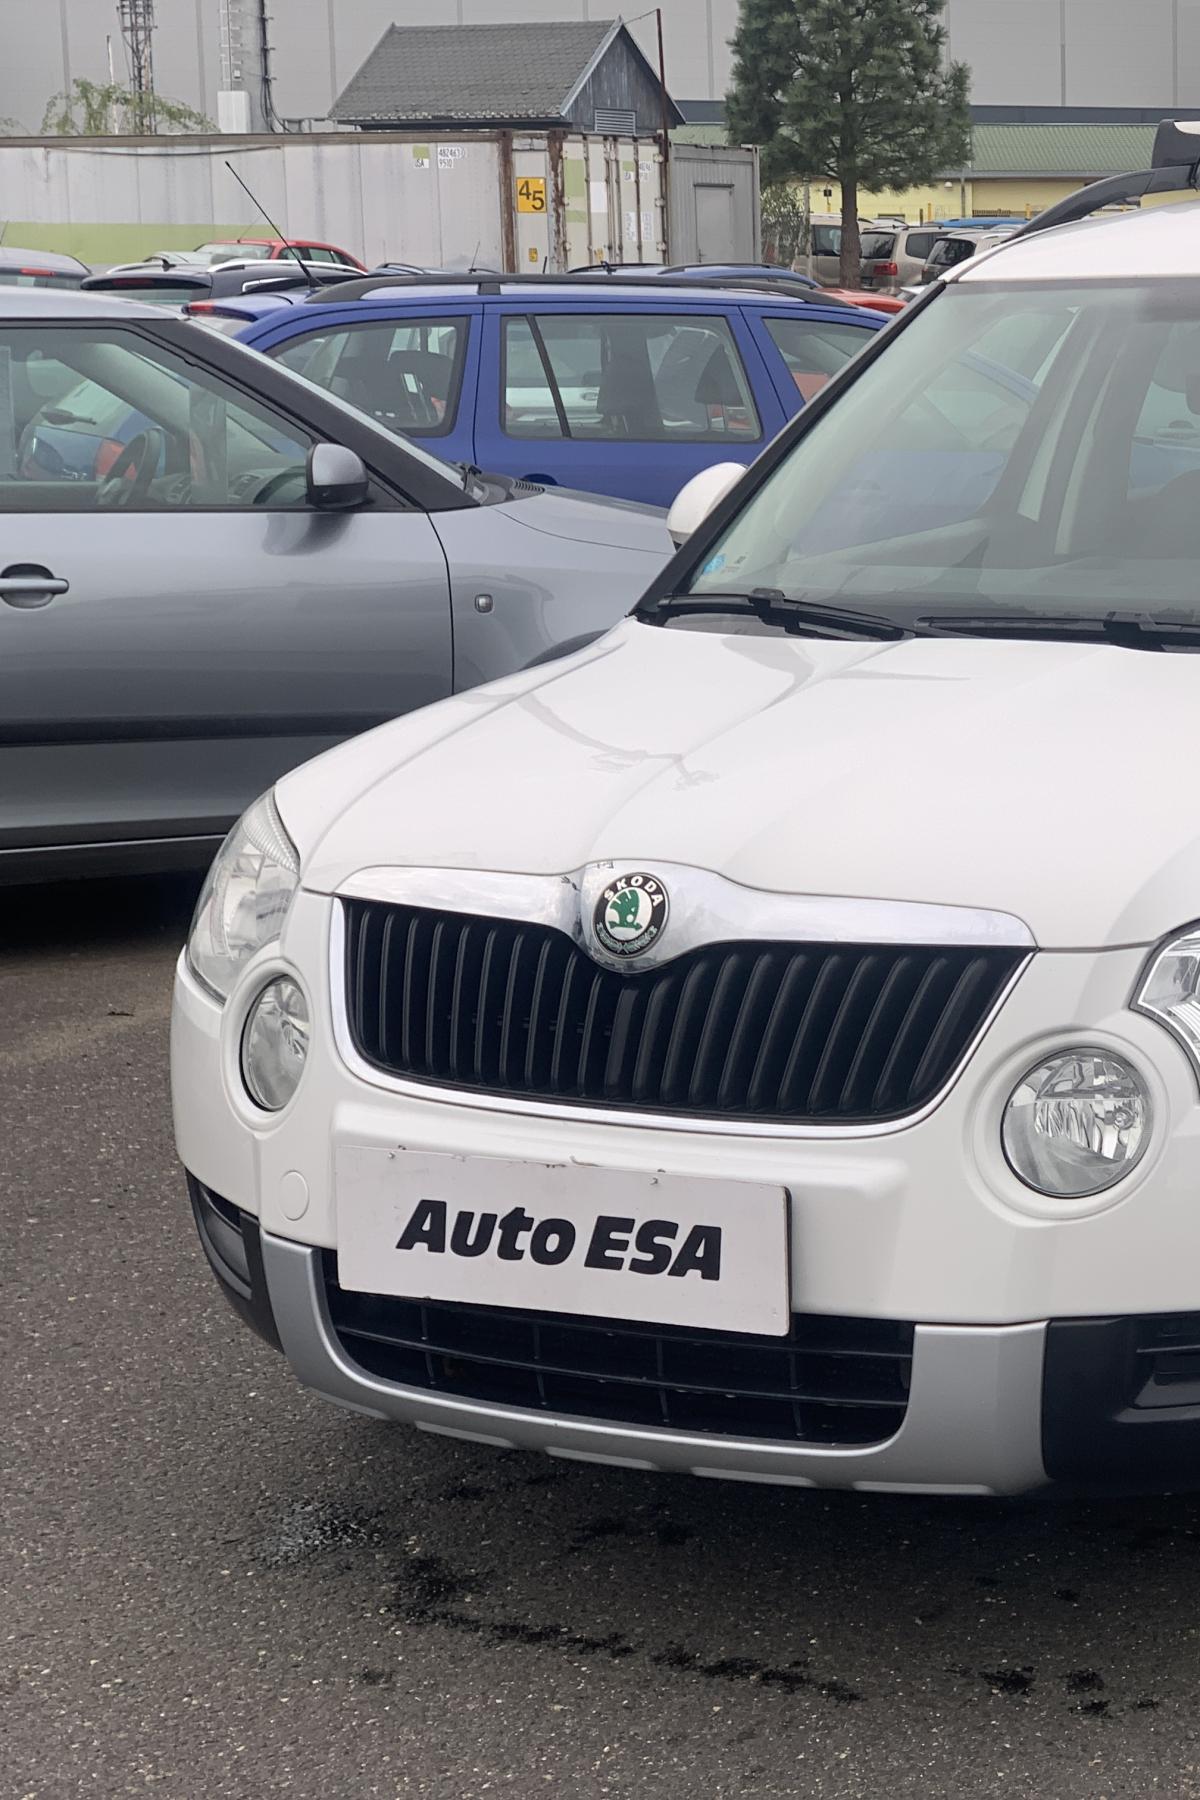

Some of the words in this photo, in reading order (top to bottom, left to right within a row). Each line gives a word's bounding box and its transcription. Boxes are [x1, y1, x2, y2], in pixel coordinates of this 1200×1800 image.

[518, 180, 545, 211] 45
[395, 1199, 577, 1266] Auto
[583, 1215, 723, 1282] ESA
